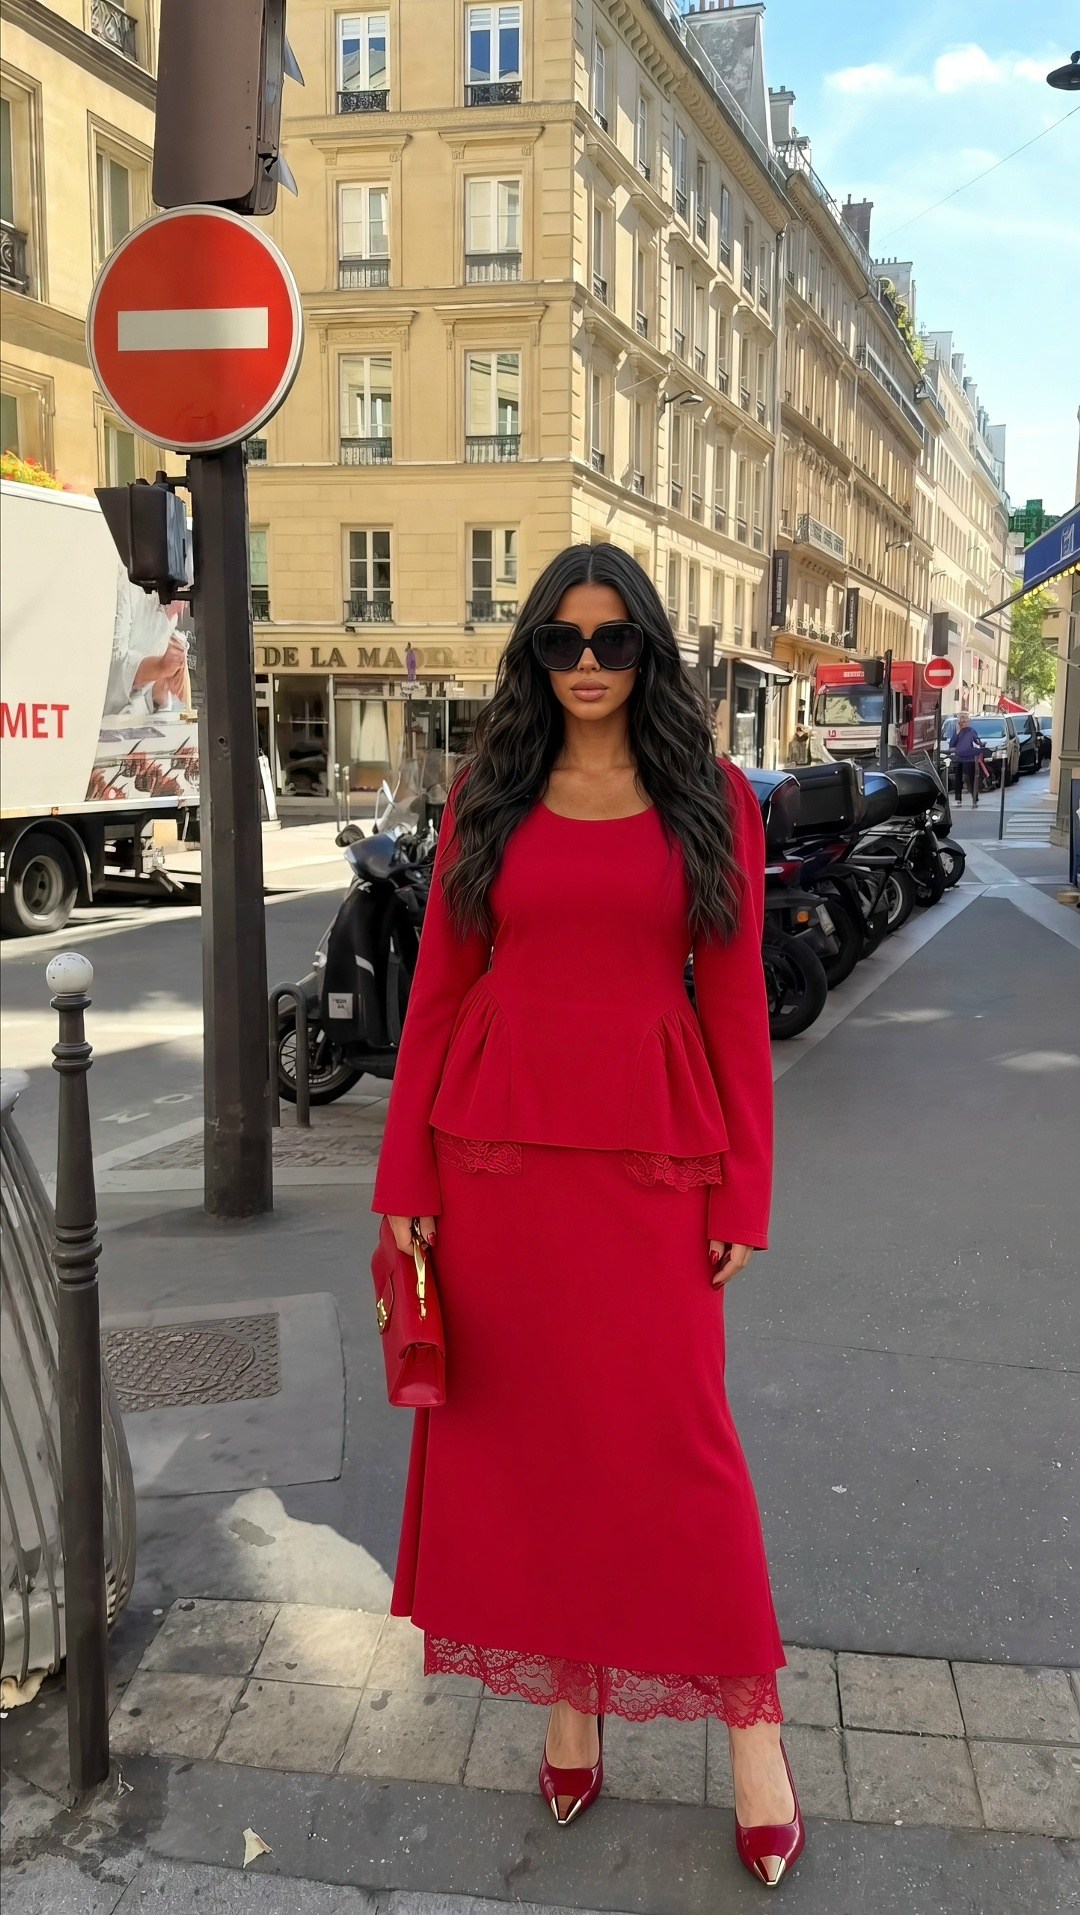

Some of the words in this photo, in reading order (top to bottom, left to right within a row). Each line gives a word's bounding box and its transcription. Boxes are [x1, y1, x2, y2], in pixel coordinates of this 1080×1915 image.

[262, 646, 300, 667] DE
[310, 647, 347, 667] LA
[0, 702, 70, 739] MET
